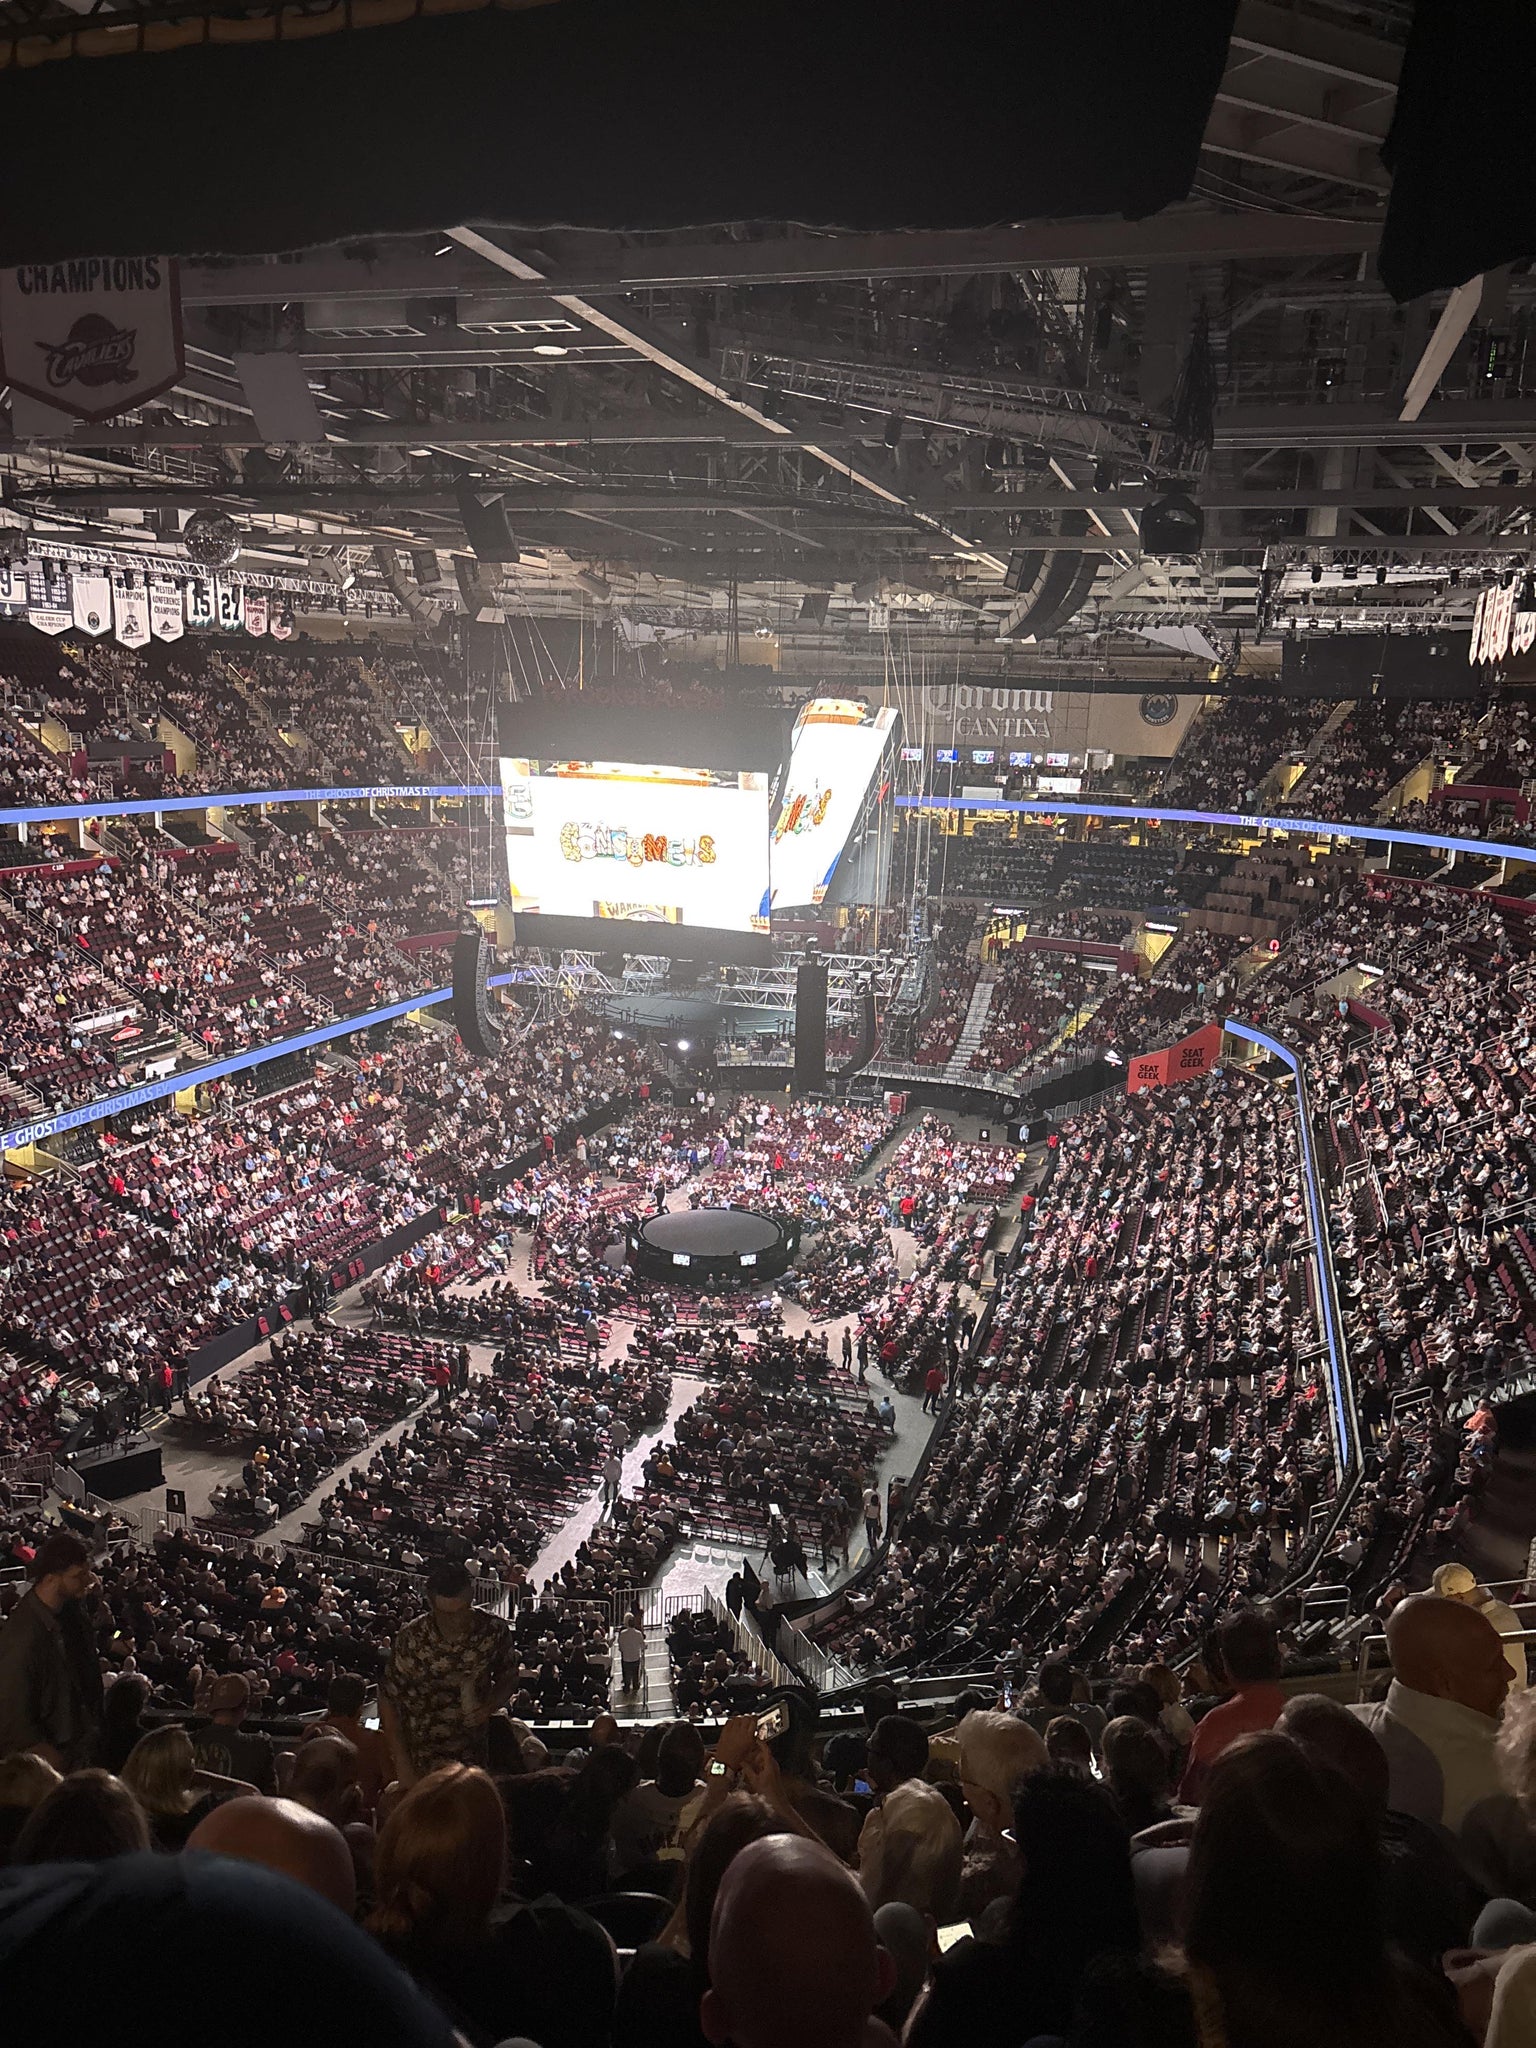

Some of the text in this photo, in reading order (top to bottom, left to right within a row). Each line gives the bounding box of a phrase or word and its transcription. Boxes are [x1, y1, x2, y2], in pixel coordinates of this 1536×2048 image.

[17, 257, 161, 295] CHAMPIONS
[153, 605, 180, 616] CHAMPIONS
[956, 716, 1052, 738] CANTINA
[304, 790, 321, 799] THE
[323, 788, 359, 799] GHOSTS
[359, 787, 371, 797] OF
[371, 786, 420, 797] CHRISTMAS
[1239, 815, 1258, 826] THE
[1261, 817, 1300, 831] GHOSTS
[1303, 821, 1317, 832] OF
[1182, 1048, 1204, 1058] SEAT
[1138, 1064, 1160, 1073] SEAT
[1180, 1058, 1204, 1068] GEEK
[1137, 1071, 1160, 1080] GEEK
[15, 1116, 67, 1146] GHOSTS
[68, 1110, 87, 1126] OF
[88, 1086, 154, 1121] CHRISTMAS
[640, 1293, 650, 1303] 10
[315, 1532, 323, 1546] 2
